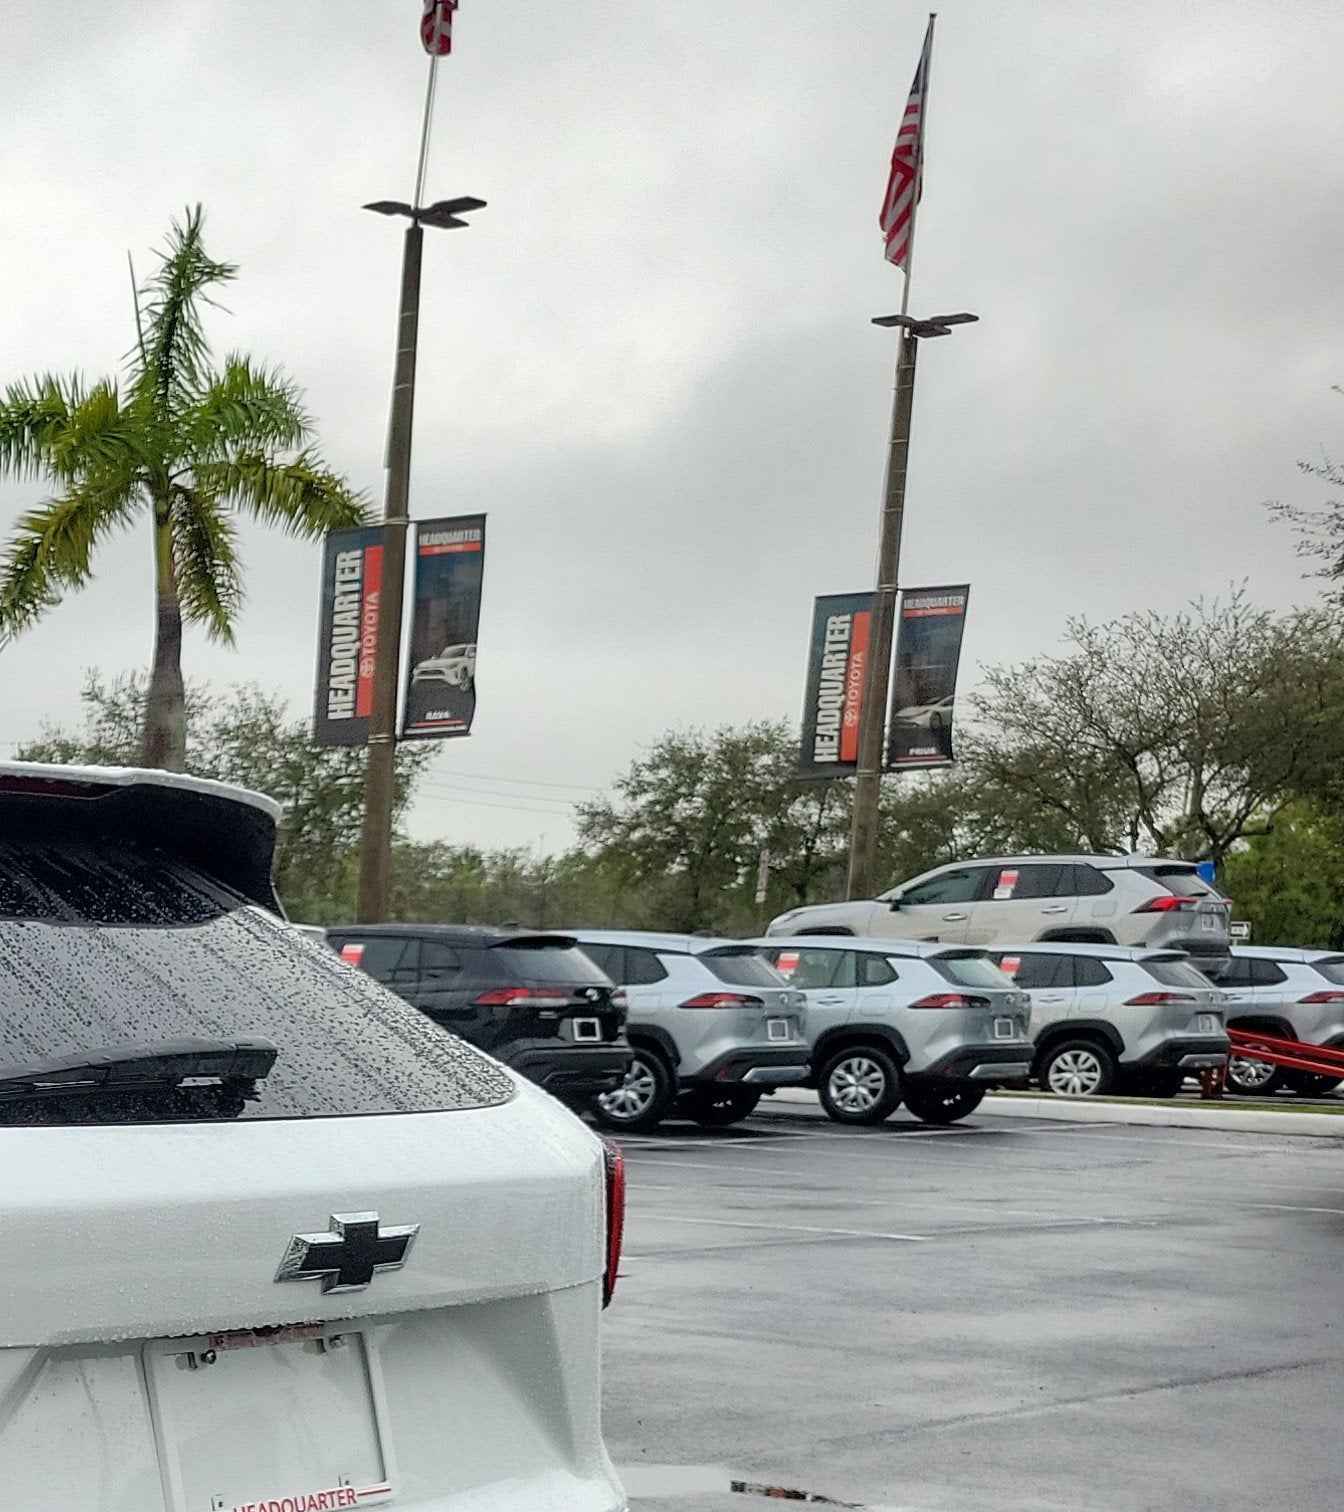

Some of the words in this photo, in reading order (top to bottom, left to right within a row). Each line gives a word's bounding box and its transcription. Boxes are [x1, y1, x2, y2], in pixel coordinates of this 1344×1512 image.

[328, 550, 363, 720] HEADQUARTER
[362, 592, 379, 654] TOYOTA
[814, 613, 852, 762] HEADQUARTER
[847, 651, 863, 706] TOYOTA
